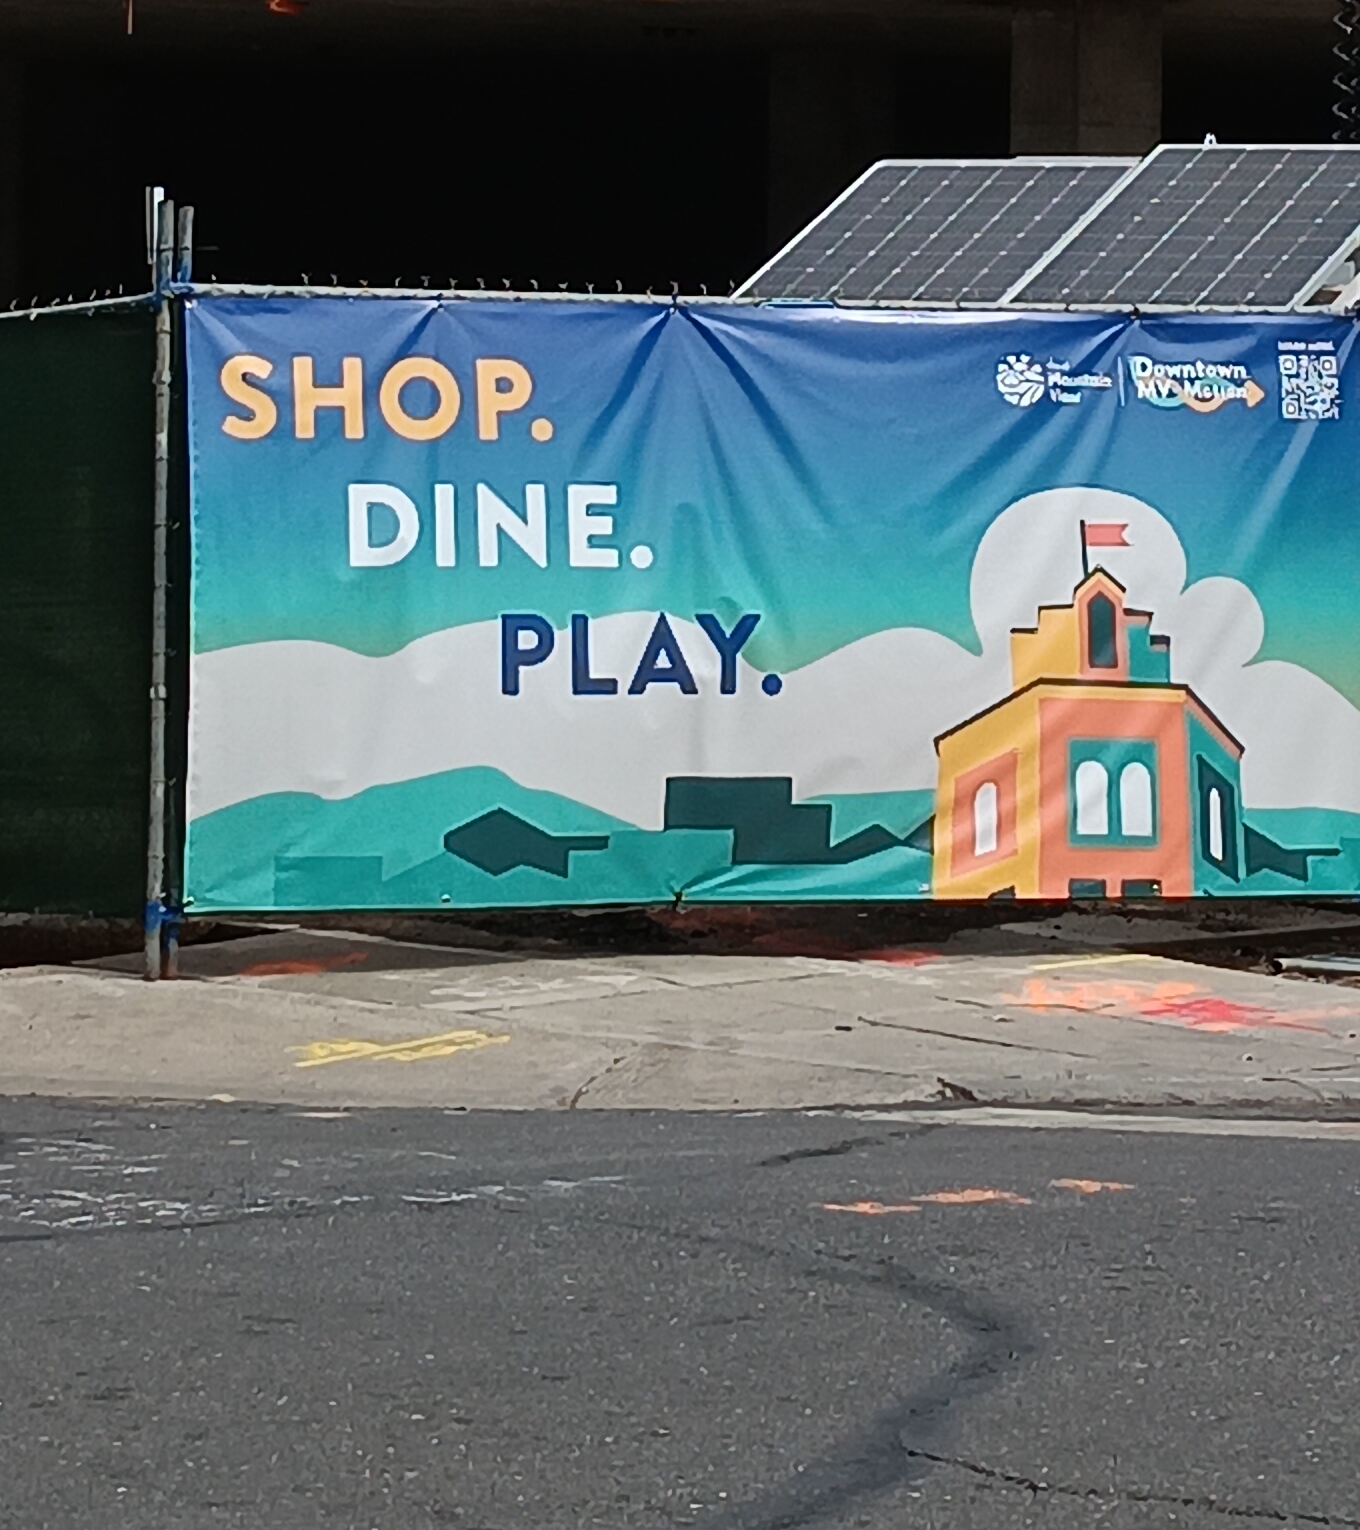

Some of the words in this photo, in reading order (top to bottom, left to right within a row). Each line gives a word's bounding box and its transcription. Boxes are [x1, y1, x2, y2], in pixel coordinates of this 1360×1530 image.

[220, 354, 554, 441] SHOP.
[1135, 356, 1250, 378] Downtown
[347, 482, 654, 568] DINE.
[500, 613, 784, 696] PLAY.
